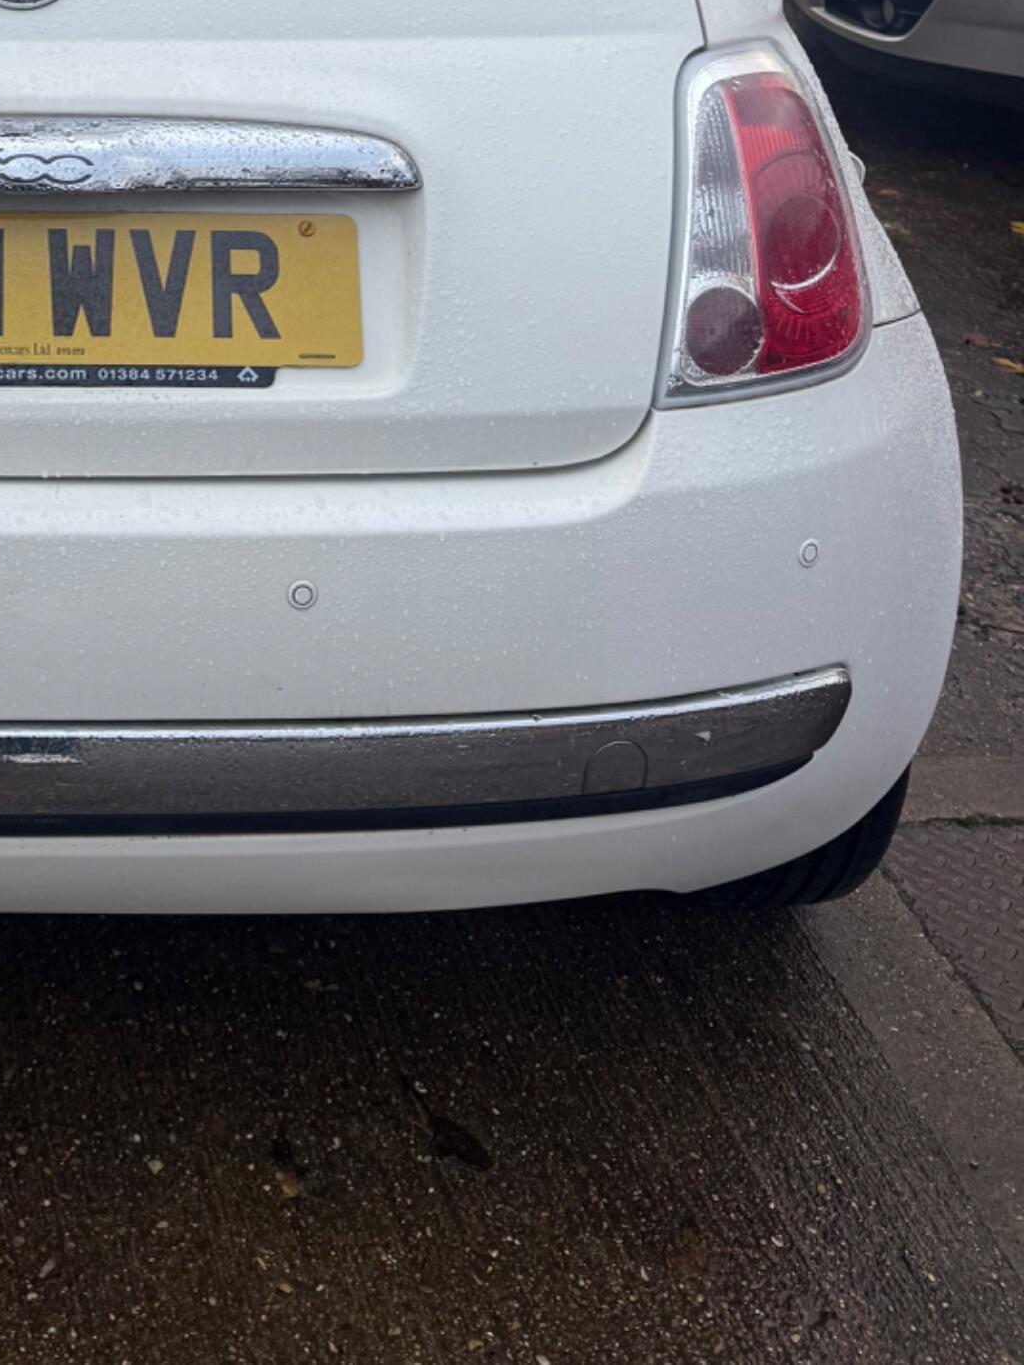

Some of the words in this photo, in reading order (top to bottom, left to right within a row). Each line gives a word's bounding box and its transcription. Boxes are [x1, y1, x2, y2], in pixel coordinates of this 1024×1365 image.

[47, 228, 281, 340] WVR
[33, 343, 51, 356] Ltd
[97, 369, 150, 381] 01384
[155, 369, 219, 381] 571234
